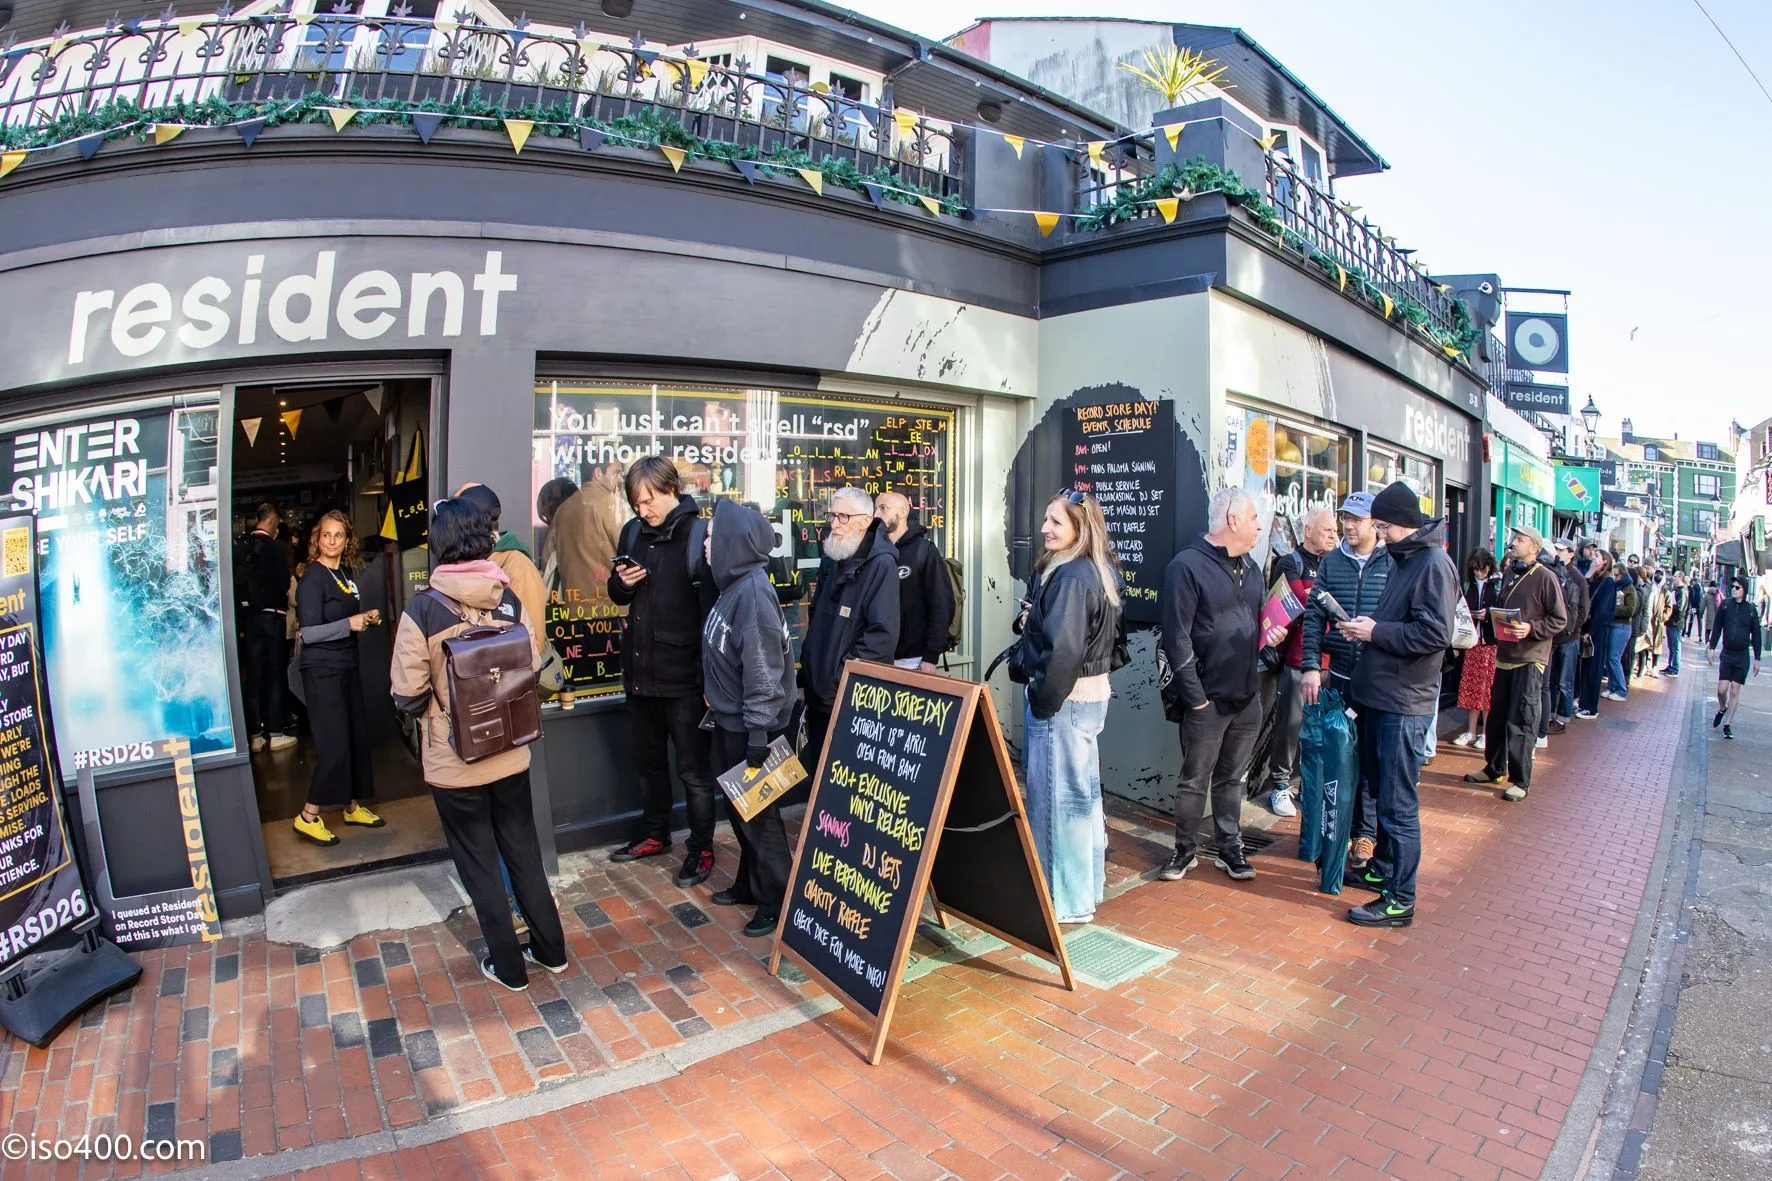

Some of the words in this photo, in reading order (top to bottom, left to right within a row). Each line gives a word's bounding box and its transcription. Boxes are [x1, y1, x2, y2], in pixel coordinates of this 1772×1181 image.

[68, 250, 518, 364] resident
[1510, 391, 1565, 405] resident
[549, 406, 602, 432] You
[608, 407, 664, 439] just
[1077, 406, 1104, 421] RECORD
[1105, 402, 1133, 417] STORE
[1226, 415, 1244, 430] CAPS
[1082, 420, 1111, 434] EVENTS
[1114, 417, 1152, 432] SCHEDULE
[1405, 405, 1470, 463] resident
[13, 418, 141, 473] ENTER
[551, 437, 665, 465] without
[1091, 440, 1111, 454] OPEN!
[1106, 462, 1129, 475] PALOMA
[1131, 460, 1156, 474] SIGNING
[11, 459, 147, 512] SHIKARI
[1115, 480, 1140, 491] SERVICE
[1139, 490, 1148, 502] DJ
[1151, 490, 1164, 501] SET
[1100, 505, 1115, 516] TEVE
[1116, 505, 1137, 516] MASON
[1138, 505, 1146, 516] DJ
[1147, 505, 1160, 516] SET
[106, 523, 147, 545] SELF
[1123, 522, 1146, 533] RAFFLE
[1116, 540, 1143, 550] WIZARD
[8, 632, 27, 648] DAY
[11, 661, 30, 678] BUT
[3, 705, 34, 728] STORE
[851, 682, 891, 720] RECORD
[891, 690, 925, 721] STORE
[922, 698, 953, 736] DAY
[74, 741, 154, 770] #RSD26
[904, 732, 927, 757] APRIL
[20, 764, 39, 783] THE
[856, 742, 876, 762] OPEN
[877, 749, 897, 772] FROM
[897, 758, 921, 782] 8AM!
[11, 778, 42, 803] LOADS
[830, 760, 856, 788] 500+
[858, 772, 911, 815] EXCLUSIVE
[6, 792, 49, 821] SERVING.
[23, 824, 44, 840] FOR
[816, 809, 851, 848] SIGNINGS
[850, 794, 875, 824] VINYL
[875, 808, 925, 852] RELEASES
[163, 738, 222, 942] resident
[862, 843, 877, 869] DJ
[878, 851, 903, 890] SETS
[812, 847, 835, 876] LIVE
[834, 858, 893, 914] PERFORMANCE
[115, 923, 126, 932] on
[127, 916, 160, 930] Record
[160, 914, 185, 925] Store
[186, 911, 204, 921] Day
[117, 905, 150, 920] queued
[151, 904, 161, 914] at
[161, 899, 202, 912] Resident
[804, 878, 837, 918] CHARITY
[836, 901, 872, 940] RAFFLE
[0, 888, 87, 961] #RSD26
[116, 932, 132, 943] and
[133, 929, 150, 941] this
[151, 929, 160, 938] is
[160, 924, 184, 937] what
[190, 921, 210, 934] got.
[793, 908, 812, 936] CHECK
[814, 923, 829, 946] DICE
[829, 935, 844, 964] FOR
[844, 949, 864, 975] MORE
[865, 963, 886, 992] INFO!
